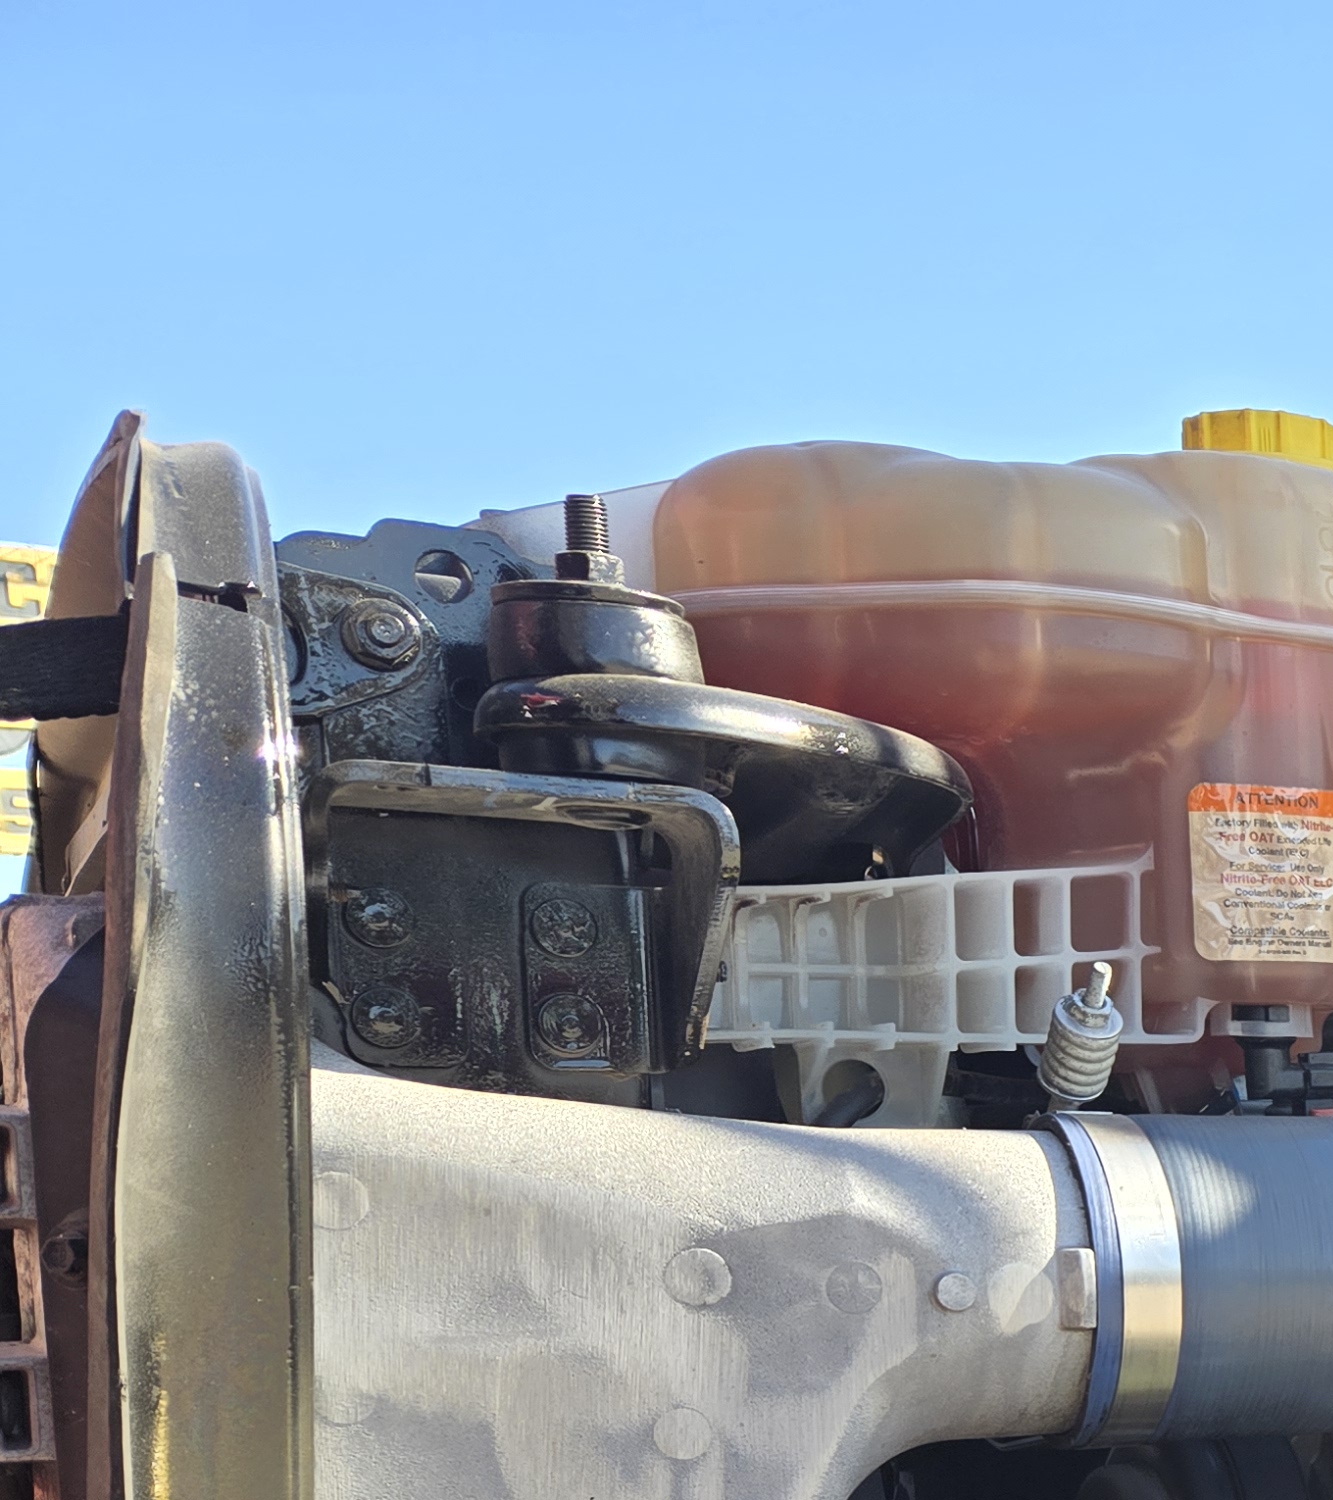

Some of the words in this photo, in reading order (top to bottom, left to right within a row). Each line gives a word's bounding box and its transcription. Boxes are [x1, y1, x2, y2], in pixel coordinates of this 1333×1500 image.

[1236, 791, 1319, 809] ATTENTION
[1219, 832, 1245, 843] Free
[1249, 831, 1275, 844] OAT
[1230, 861, 1245, 871] For
[1313, 877, 1333, 888] ELC
